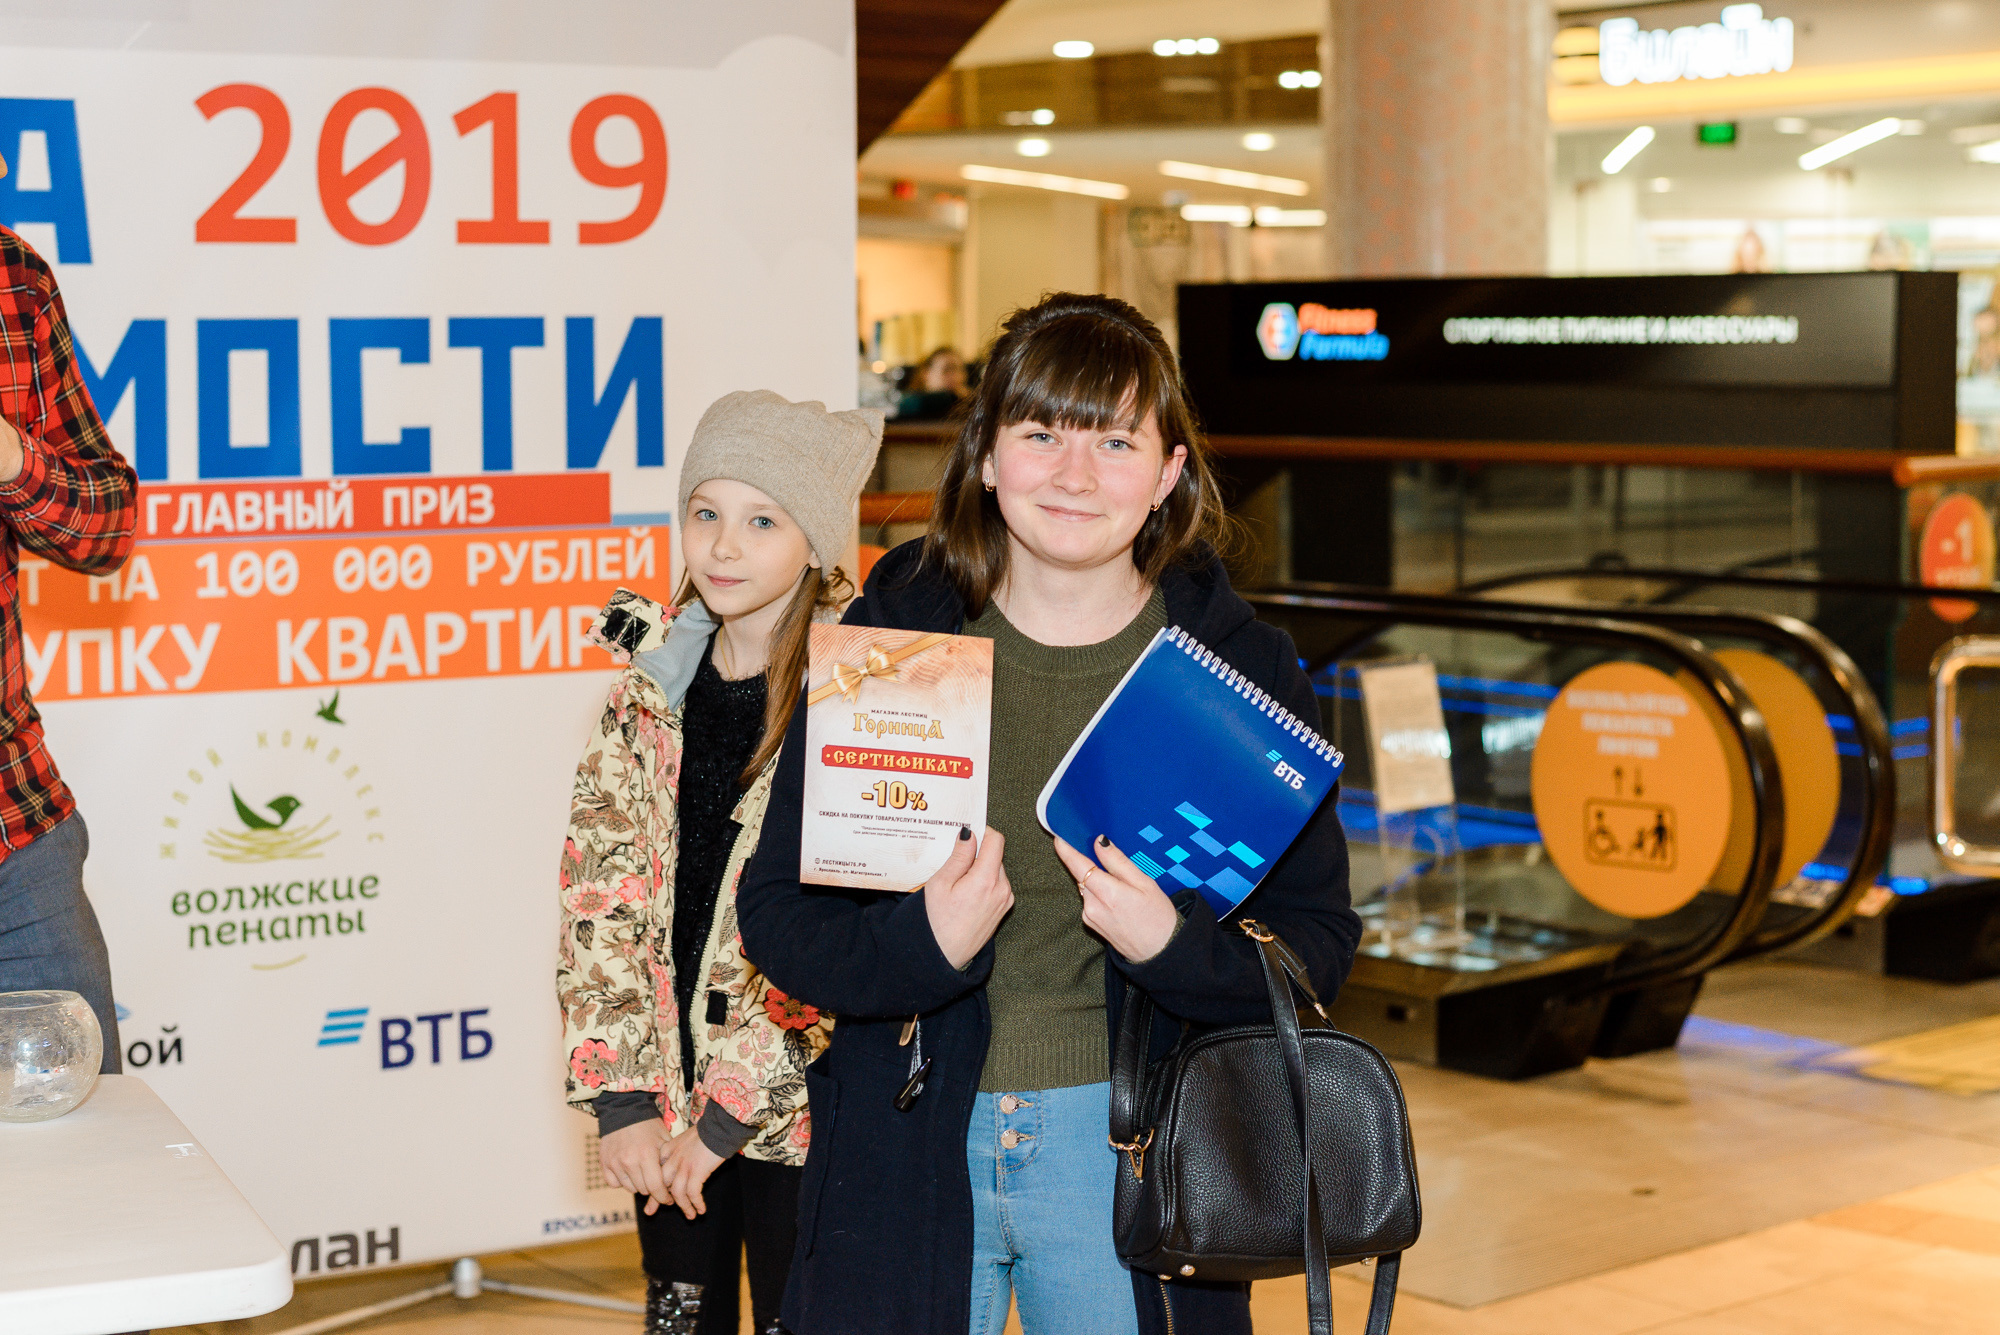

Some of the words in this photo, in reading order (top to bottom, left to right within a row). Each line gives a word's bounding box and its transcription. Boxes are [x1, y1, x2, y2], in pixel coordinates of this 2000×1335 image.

[193, 82, 669, 247] 2019
[146, 480, 354, 534] ГЛАВНЫЙ
[382, 484, 495, 525] ПРИЗ
[88, 555, 160, 603] НА
[195, 549, 300, 598] 100
[333, 544, 433, 592] 000
[465, 528, 656, 586] РУБЛЕЙ
[276, 605, 627, 684] КВАРТИР
[900, 711, 928, 719] ЛЕСТНИЦ
[833, 750, 962, 774] СЕРТИФИКАТ
[1273, 760, 1306, 790] ВТБ
[819, 810, 840, 818] СКИДКА
[875, 815, 917, 824] ТОВАРА/УСЛУГИ
[861, 780, 928, 811] -10%
[170, 873, 381, 918] волжские
[187, 910, 367, 951] пенаты
[379, 1007, 494, 1071] ВТБ
